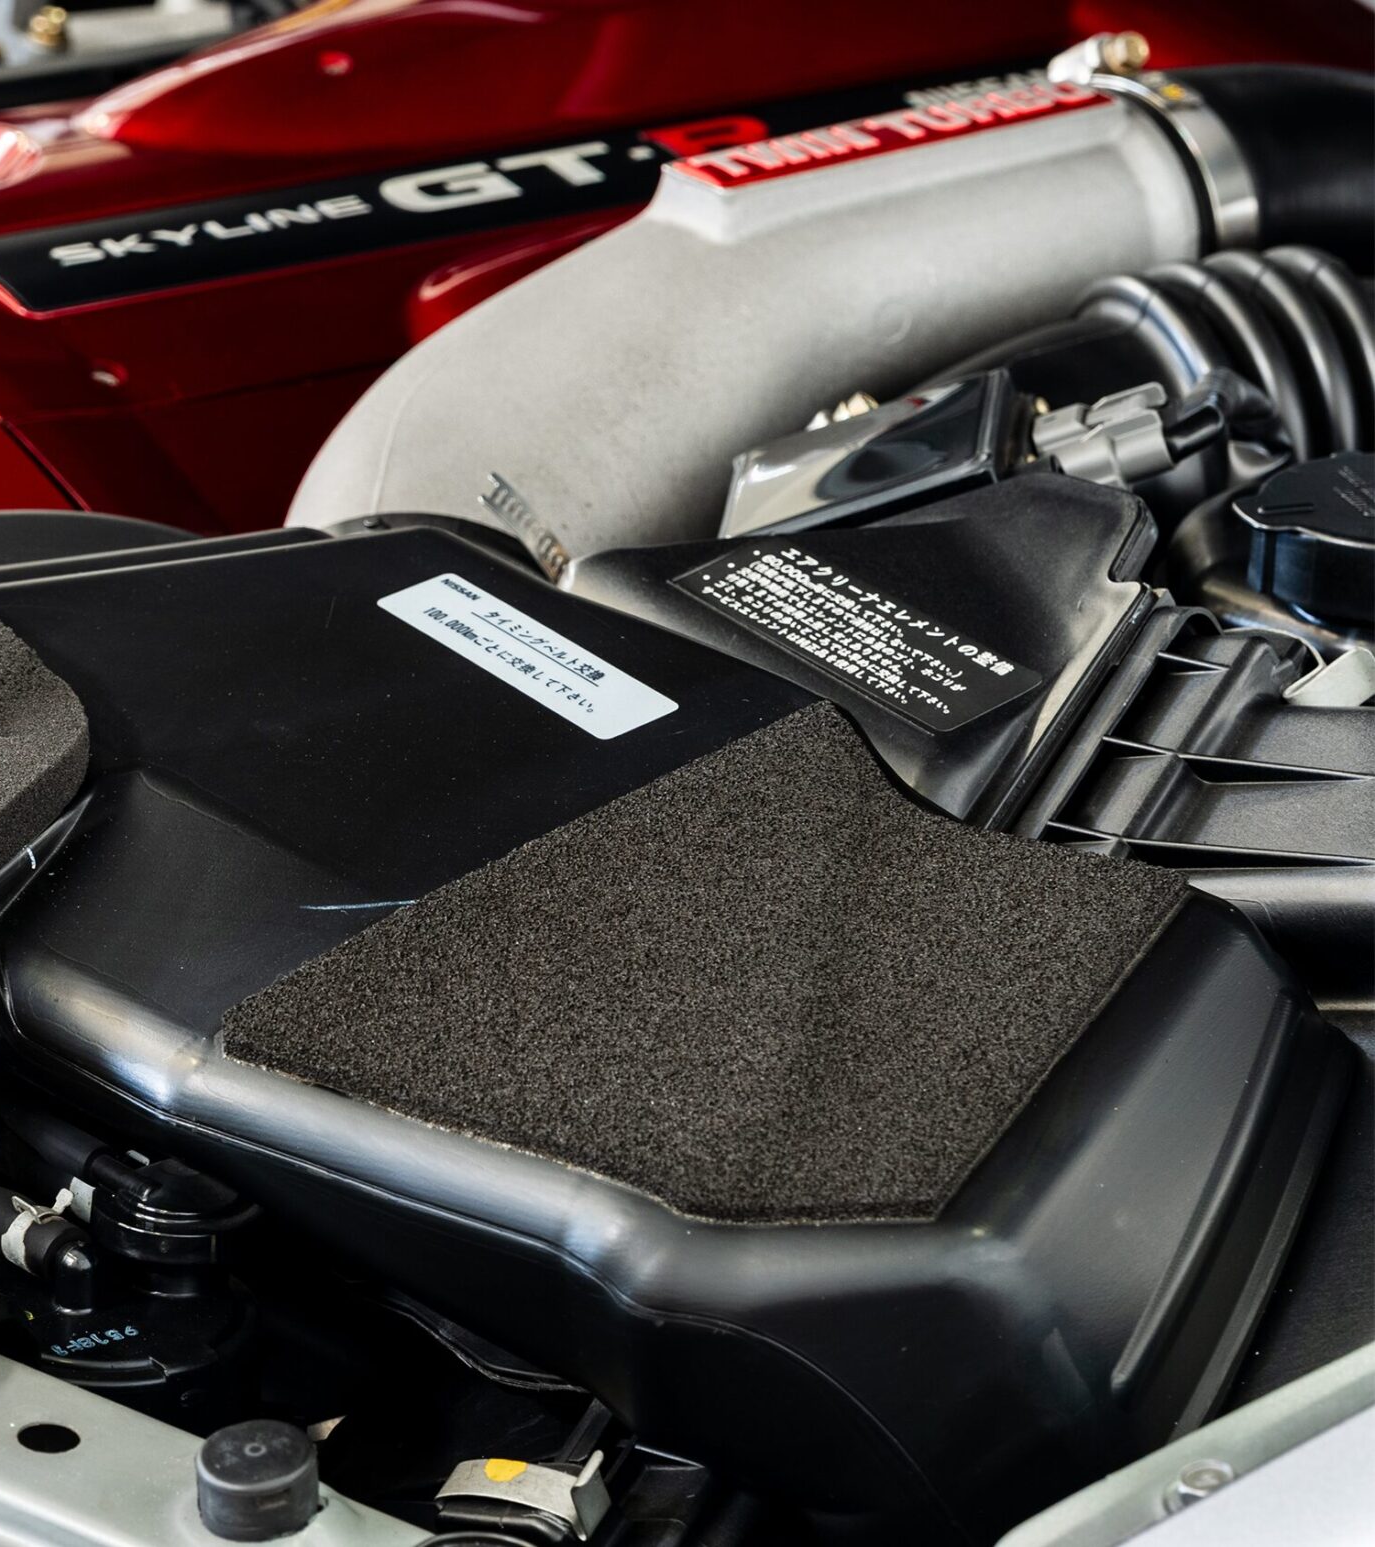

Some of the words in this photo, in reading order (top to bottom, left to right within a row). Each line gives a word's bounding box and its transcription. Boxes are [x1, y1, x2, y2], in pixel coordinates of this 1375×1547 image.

[689, 120, 881, 178] TWIN
[861, 82, 1097, 140] TURBO
[49, 194, 371, 267] SKYLINE
[440, 578, 482, 601] NISSAN
[781, 548, 1014, 676] エアクリーナエレメントの整備
[484, 610, 606, 682] タイミングベルト交換
